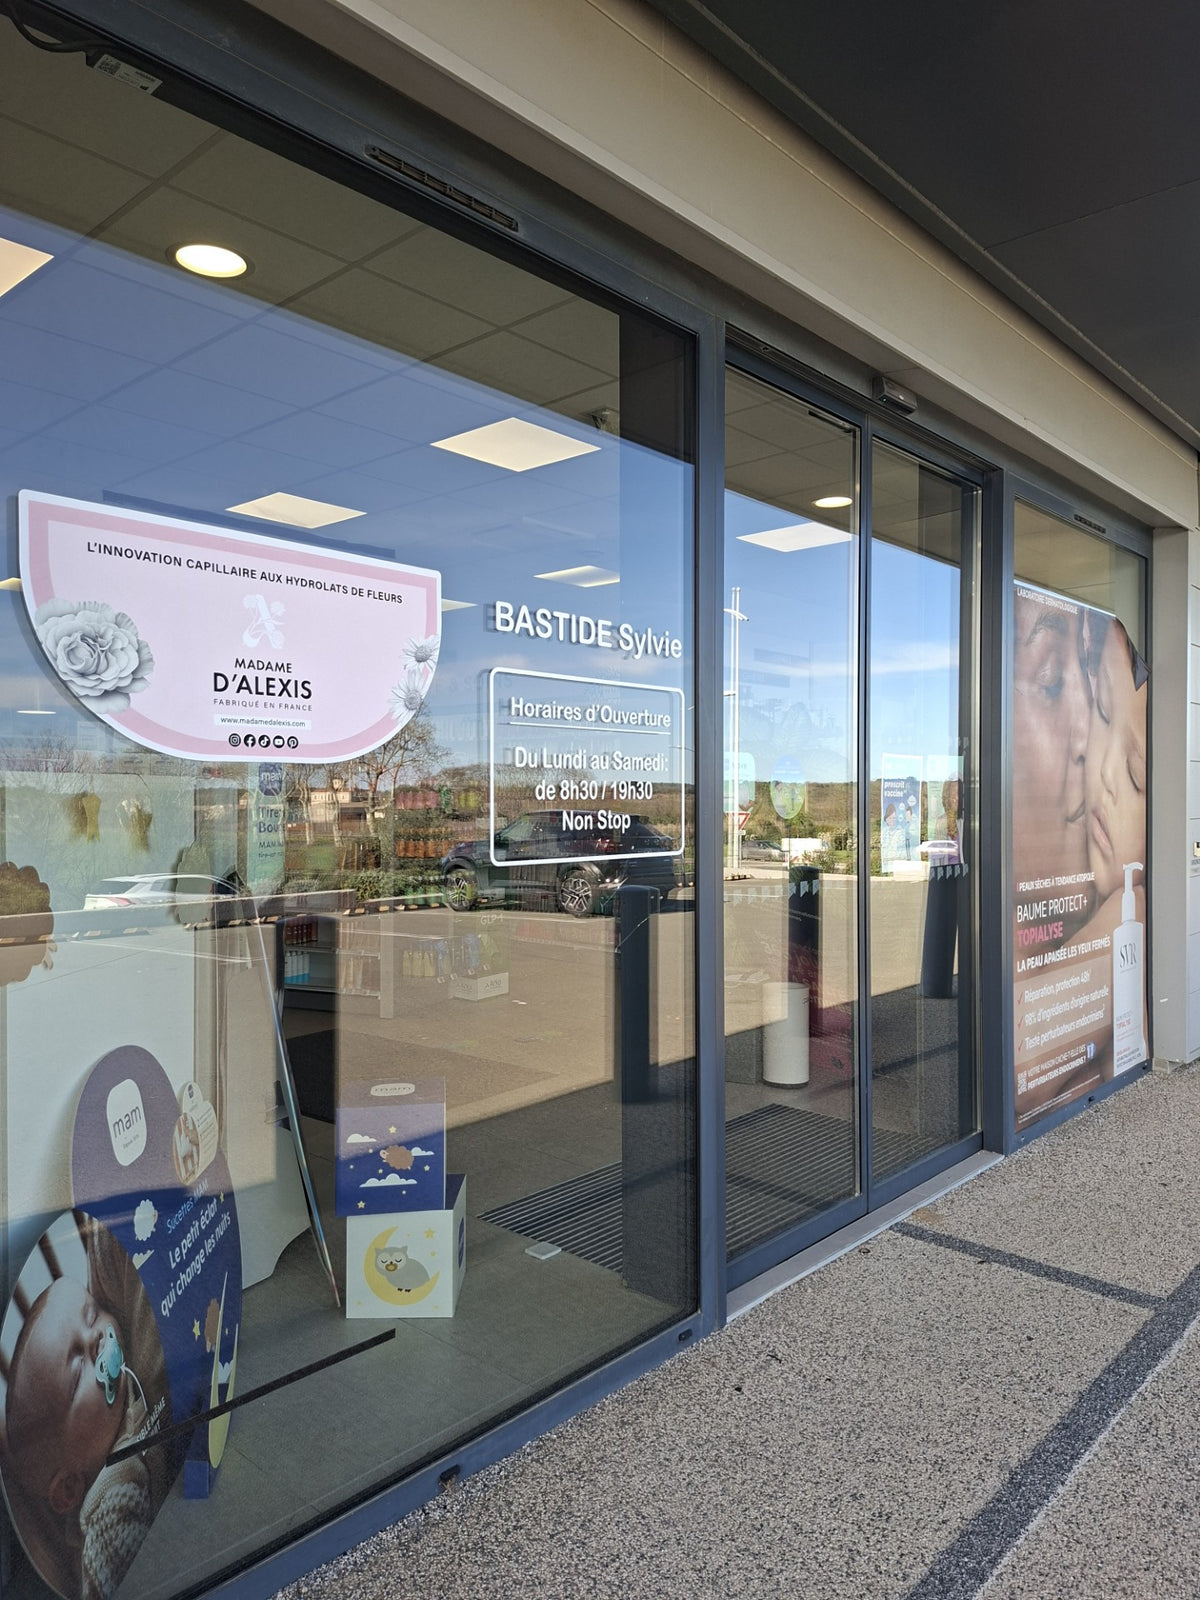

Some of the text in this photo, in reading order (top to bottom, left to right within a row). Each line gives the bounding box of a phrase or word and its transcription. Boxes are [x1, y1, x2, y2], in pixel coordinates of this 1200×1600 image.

[87, 541, 403, 604] L'INNOVATION CAPILLAIRE AUX HYDROLATS DE FLEURS
[494, 600, 682, 660] BASTIDE Sylvie
[234, 657, 293, 674] MADAME
[213, 671, 313, 700] D'ALEXIS
[213, 698, 313, 712] FABRIQUÉ EN FRANCE
[510, 696, 672, 728] Horaires d'Ouverture
[220, 717, 306, 727] www.madamedalexis.com
[514, 746, 669, 772] Du Lundi au Samedi:
[535, 779, 653, 800] de 8h30 / 19h30
[562, 809, 631, 834] Non Stop
[1017, 894, 1088, 923] BAUME PROTECT+
[1017, 921, 1064, 947] TOPIALYSE
[1017, 960, 1027, 972] LA
[1027, 954, 1043, 970] PEAU
[1067, 946, 1077, 959] LES
[1077, 941, 1091, 955] YEUX
[1119, 943, 1138, 968] SVR
[112, 1106, 142, 1138] mam
[166, 1197, 194, 1234] Sucettes
[168, 1197, 218, 1269] Le petit éclat
[161, 1211, 231, 1318] qui change les nuits
